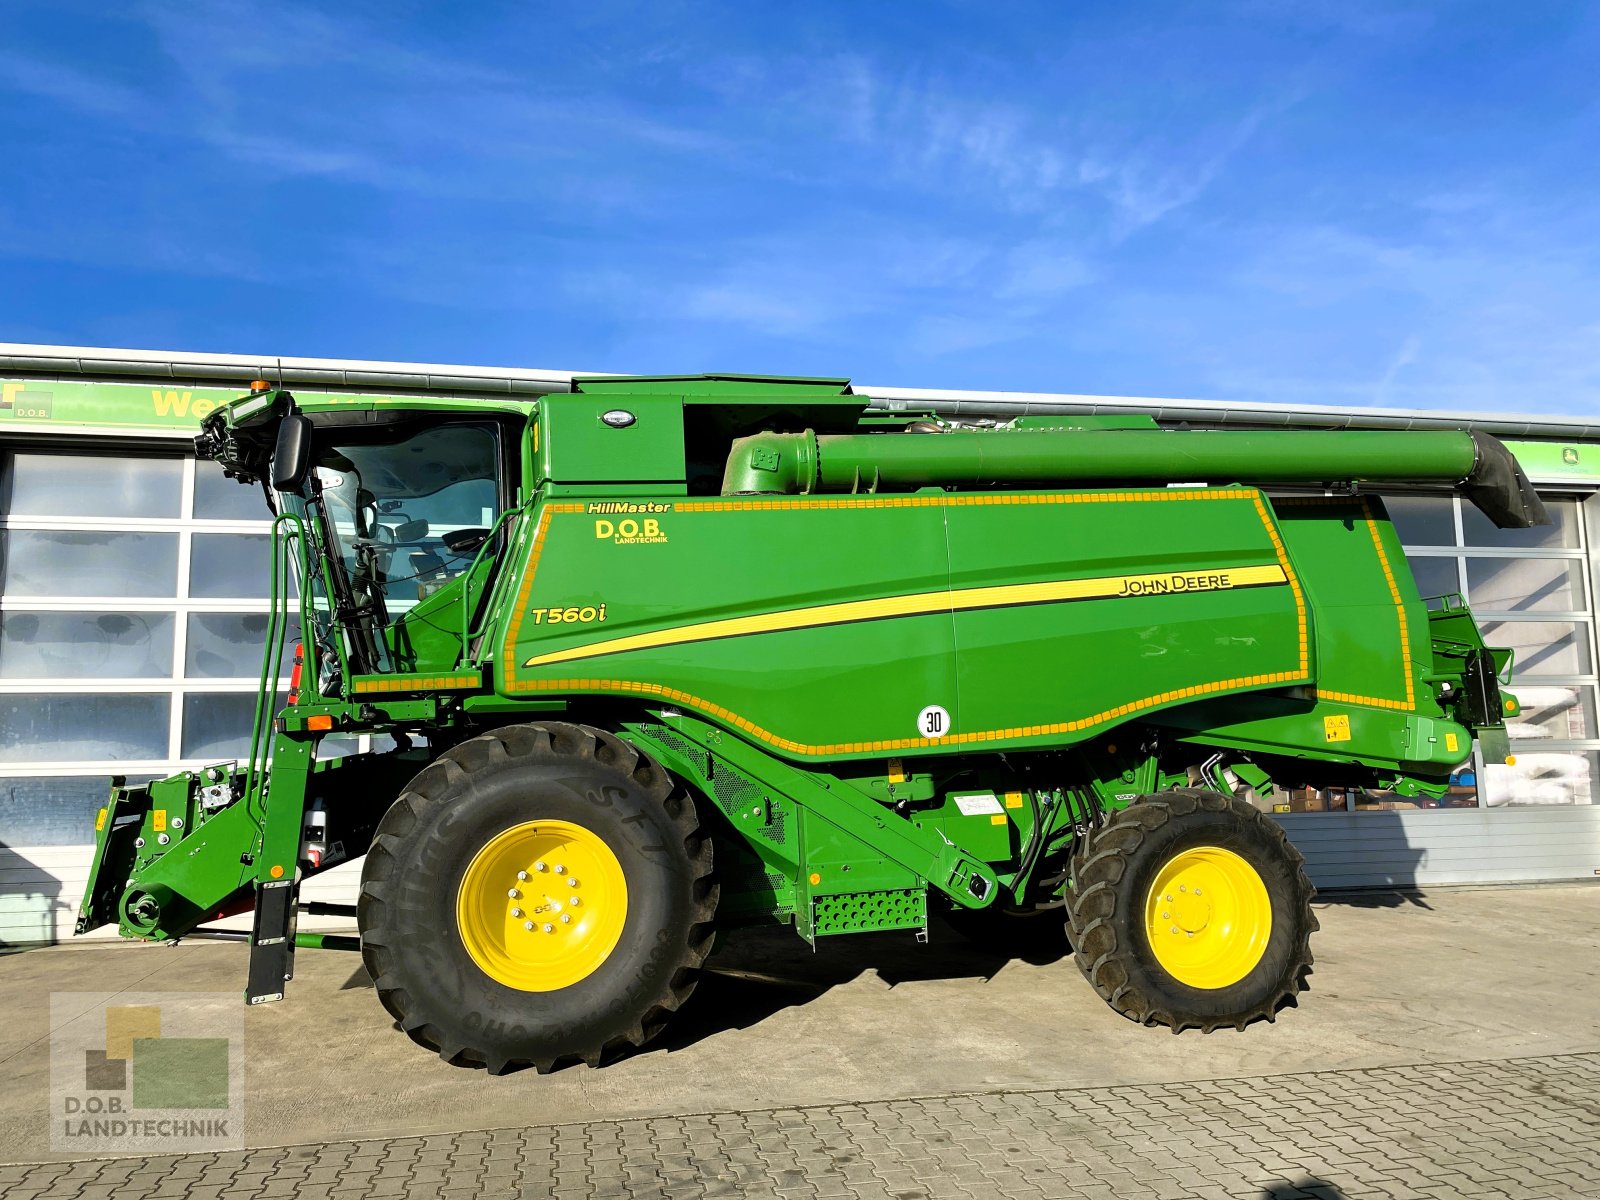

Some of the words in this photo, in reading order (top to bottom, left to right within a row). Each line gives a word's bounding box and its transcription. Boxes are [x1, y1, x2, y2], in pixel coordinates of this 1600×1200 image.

[17, 408, 49, 418] D.O.B.
[587, 502, 671, 514] HillMaster
[595, 518, 665, 539] D.O.B.
[1119, 578, 1168, 595] JOHN
[1172, 574, 1231, 590] DEERE
[532, 603, 607, 625] T560i
[926, 711, 941, 733] 30
